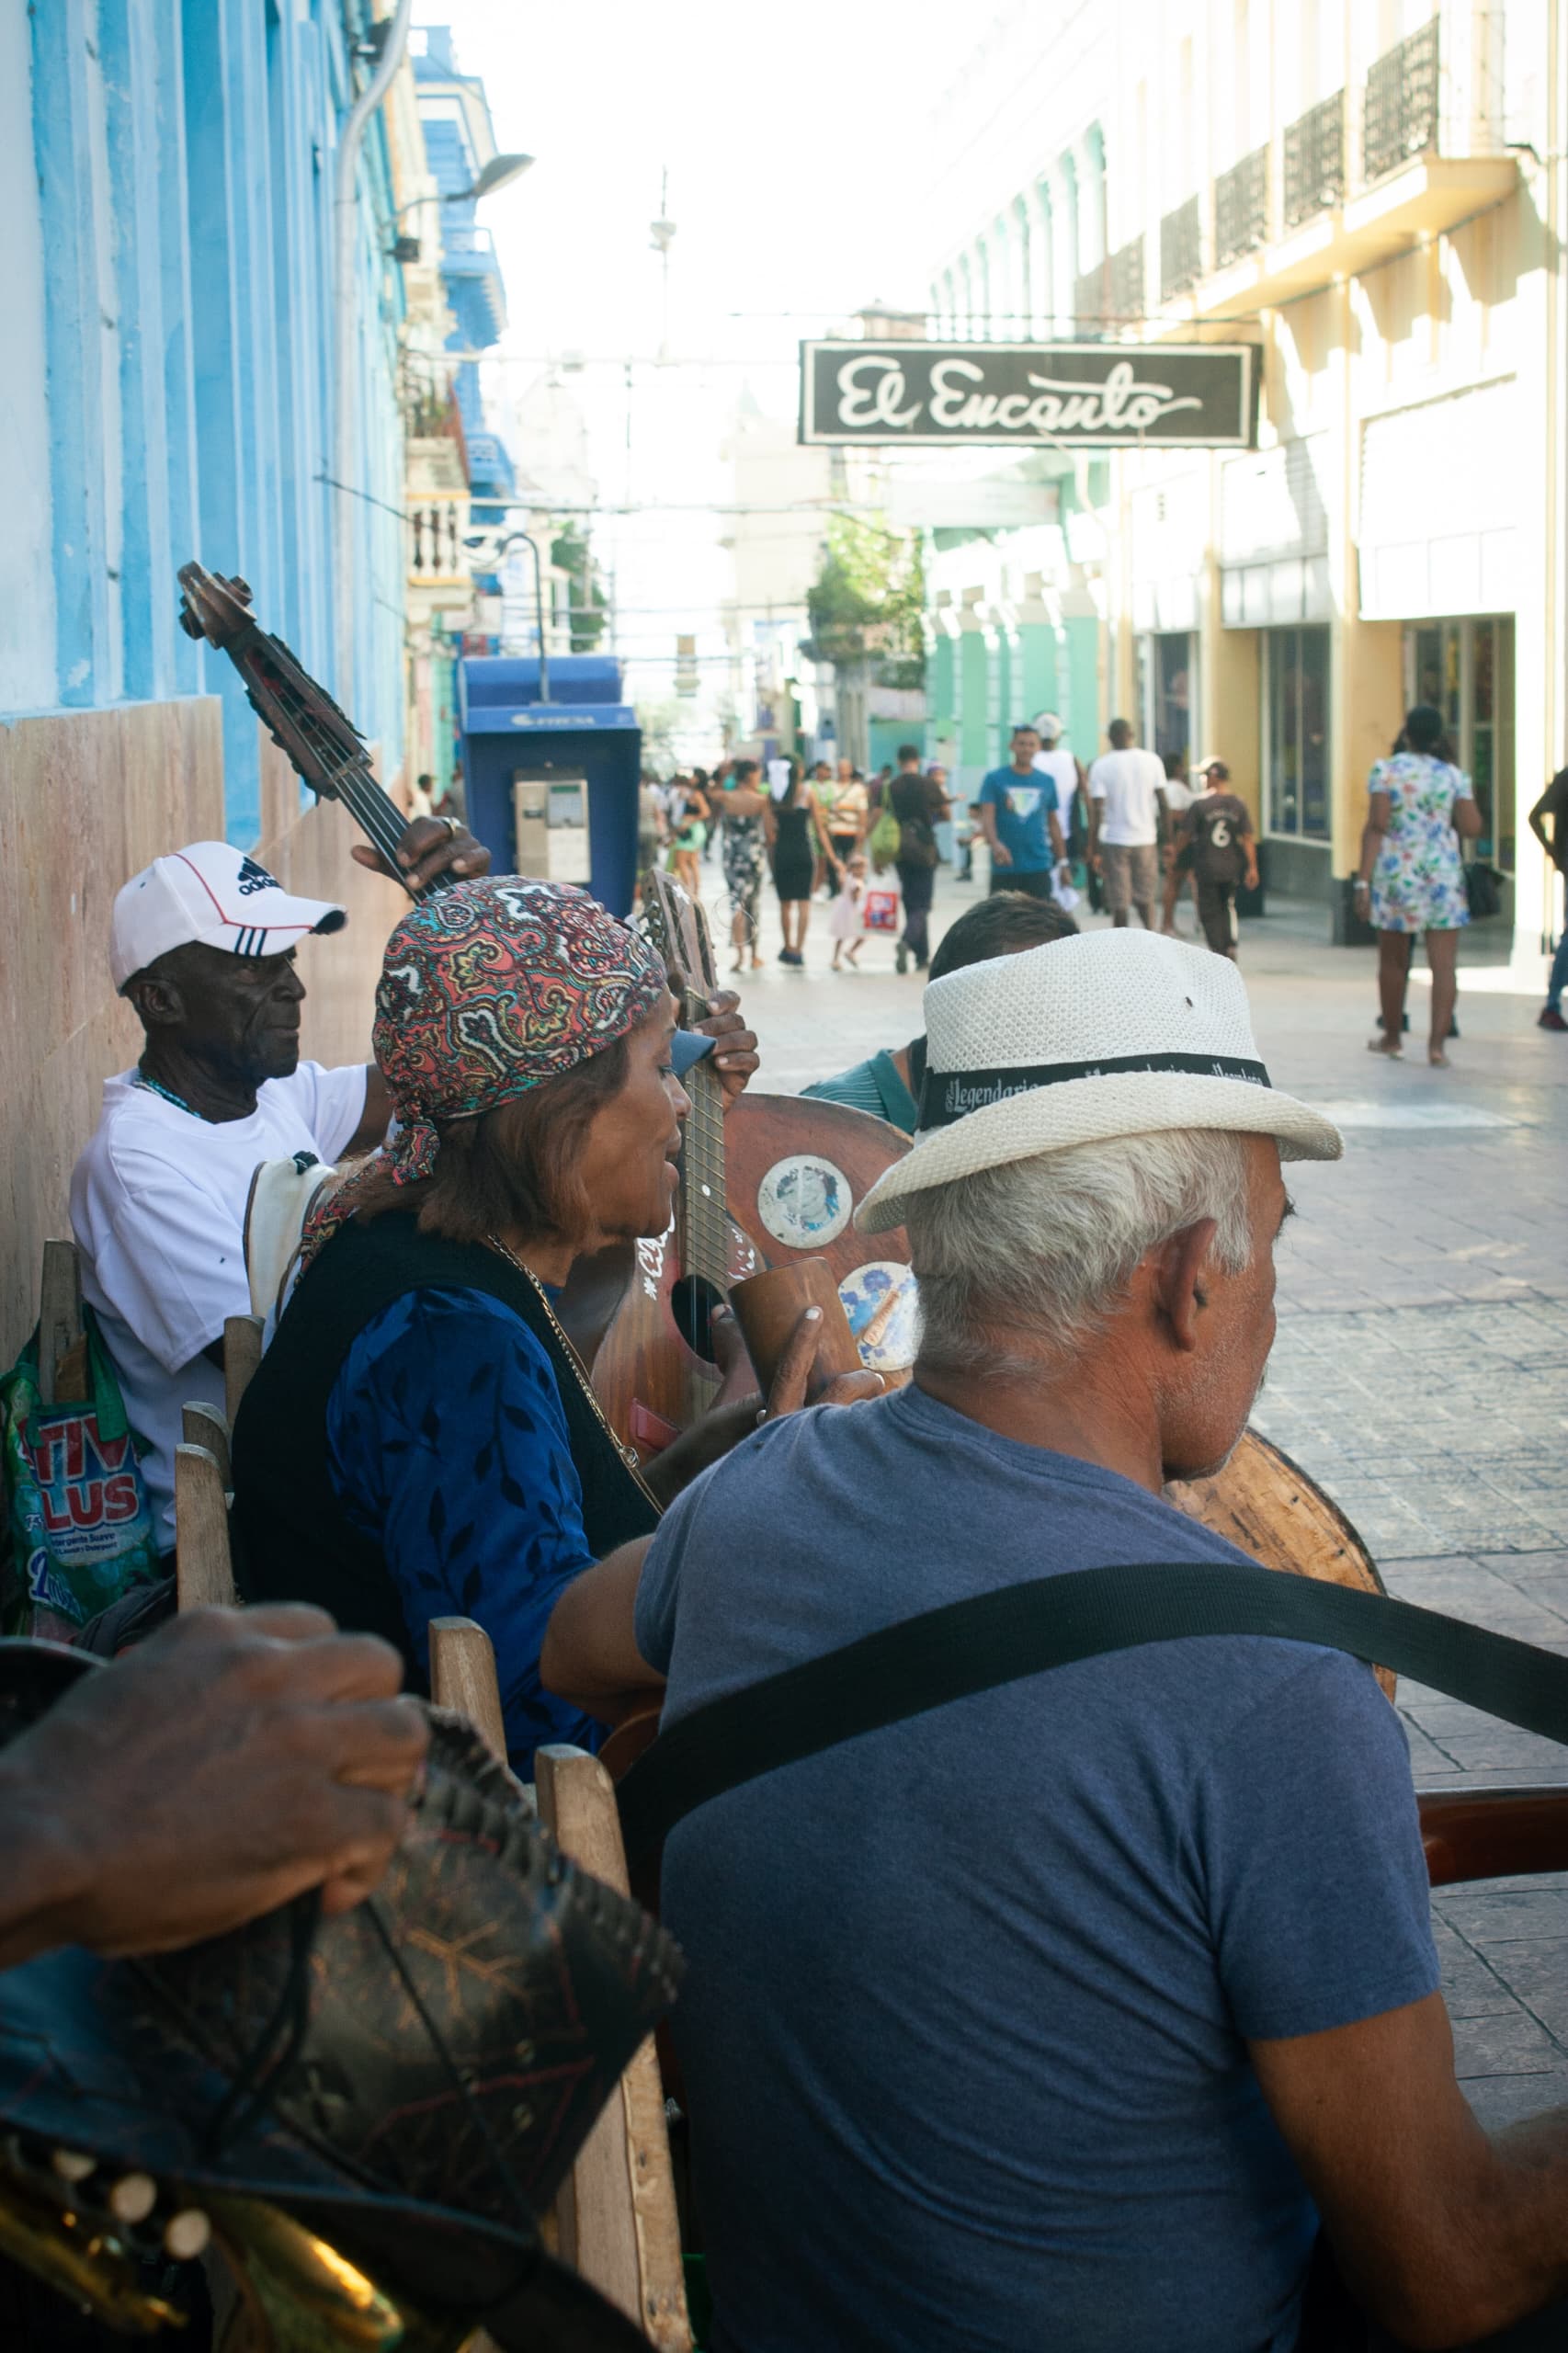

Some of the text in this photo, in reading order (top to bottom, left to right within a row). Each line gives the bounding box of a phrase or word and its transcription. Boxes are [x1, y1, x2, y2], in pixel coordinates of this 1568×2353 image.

[837, 355, 1203, 431] El Encanto
[1211, 819, 1232, 848] 6
